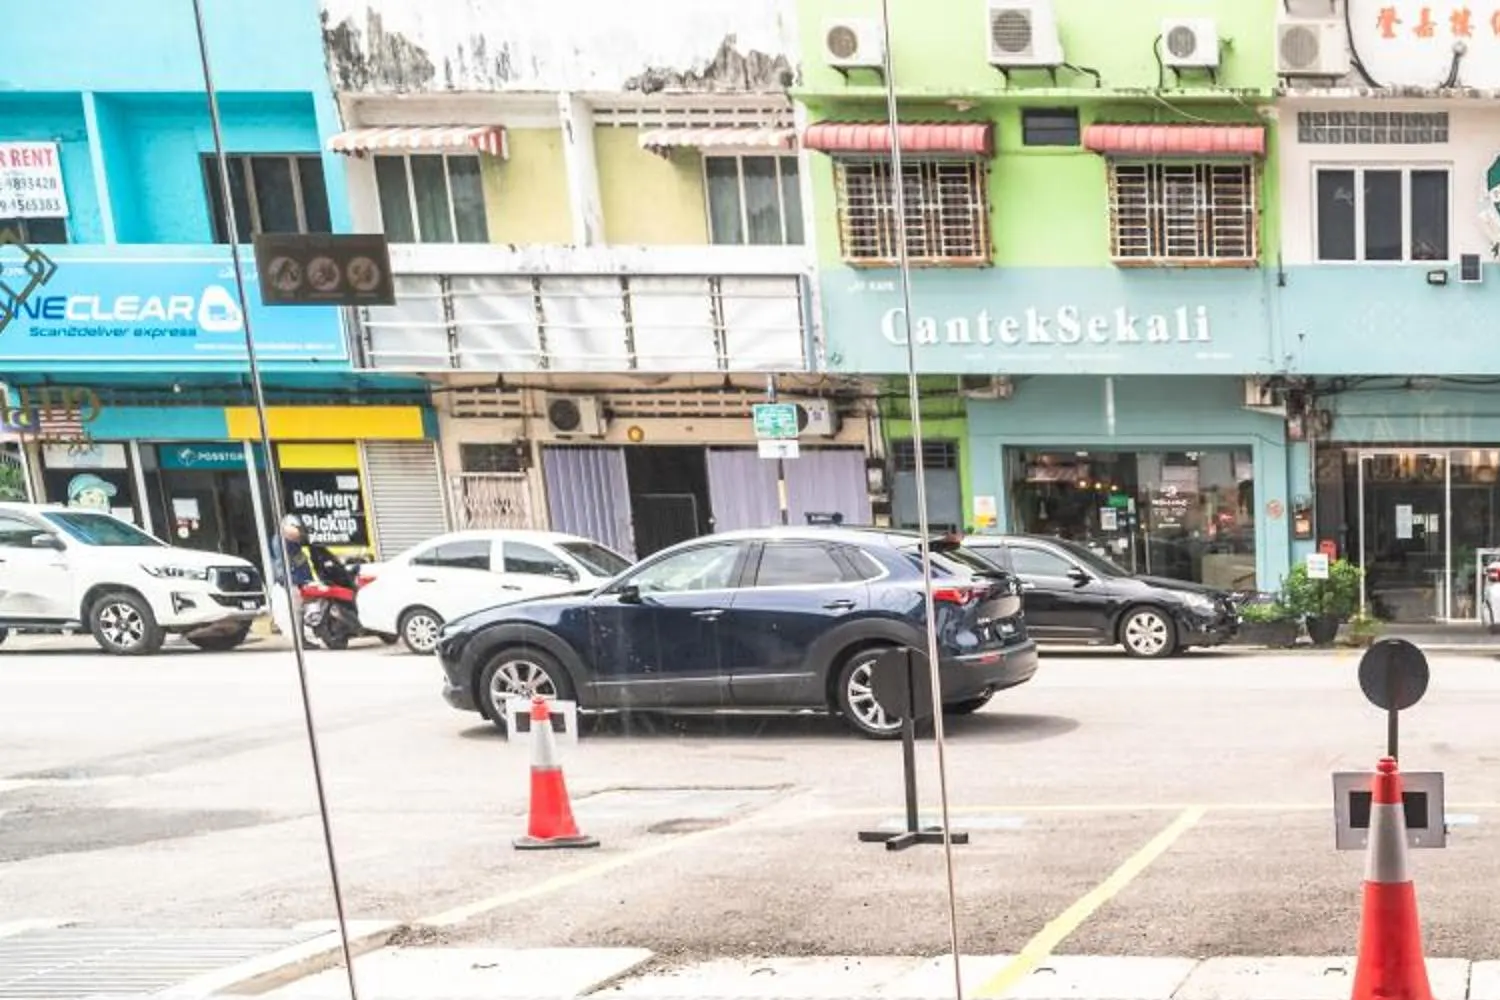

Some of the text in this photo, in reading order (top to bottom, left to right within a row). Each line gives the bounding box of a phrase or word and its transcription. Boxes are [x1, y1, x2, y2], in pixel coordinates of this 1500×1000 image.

[10, 147, 53, 167] RENT
[0, 296, 194, 321] NECLEAR
[133, 328, 197, 340] express
[881, 304, 1212, 345] CantekSekali
[293, 490, 359, 510] Delivery
